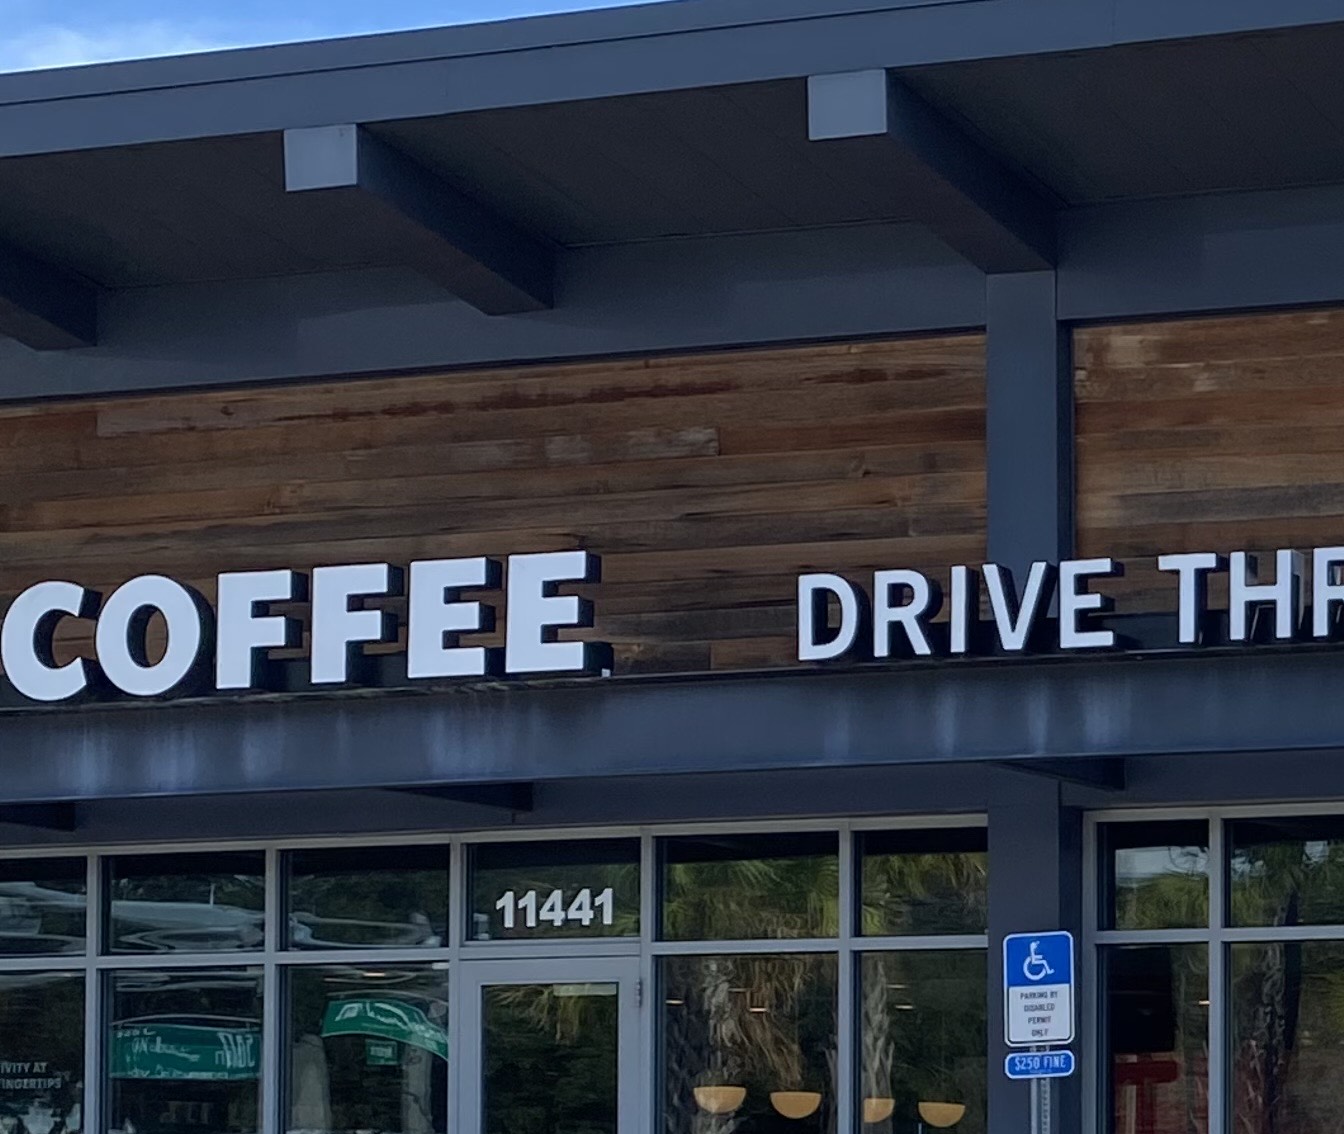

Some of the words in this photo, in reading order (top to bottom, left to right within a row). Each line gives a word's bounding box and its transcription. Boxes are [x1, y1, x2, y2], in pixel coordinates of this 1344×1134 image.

[799, 557, 1116, 661] DRIVE
[1, 550, 593, 700] COFFEE
[495, 887, 613, 929] 11441
[1020, 991, 1048, 1000] PARKING
[1049, 991, 1058, 999] BY
[1023, 1003, 1055, 1012] DISABLED
[1027, 1016, 1052, 1025] PERMIT
[1031, 1028, 1049, 1037] ONLY
[1014, 1056, 1040, 1071] $250
[1043, 1055, 1067, 1069] FINE
